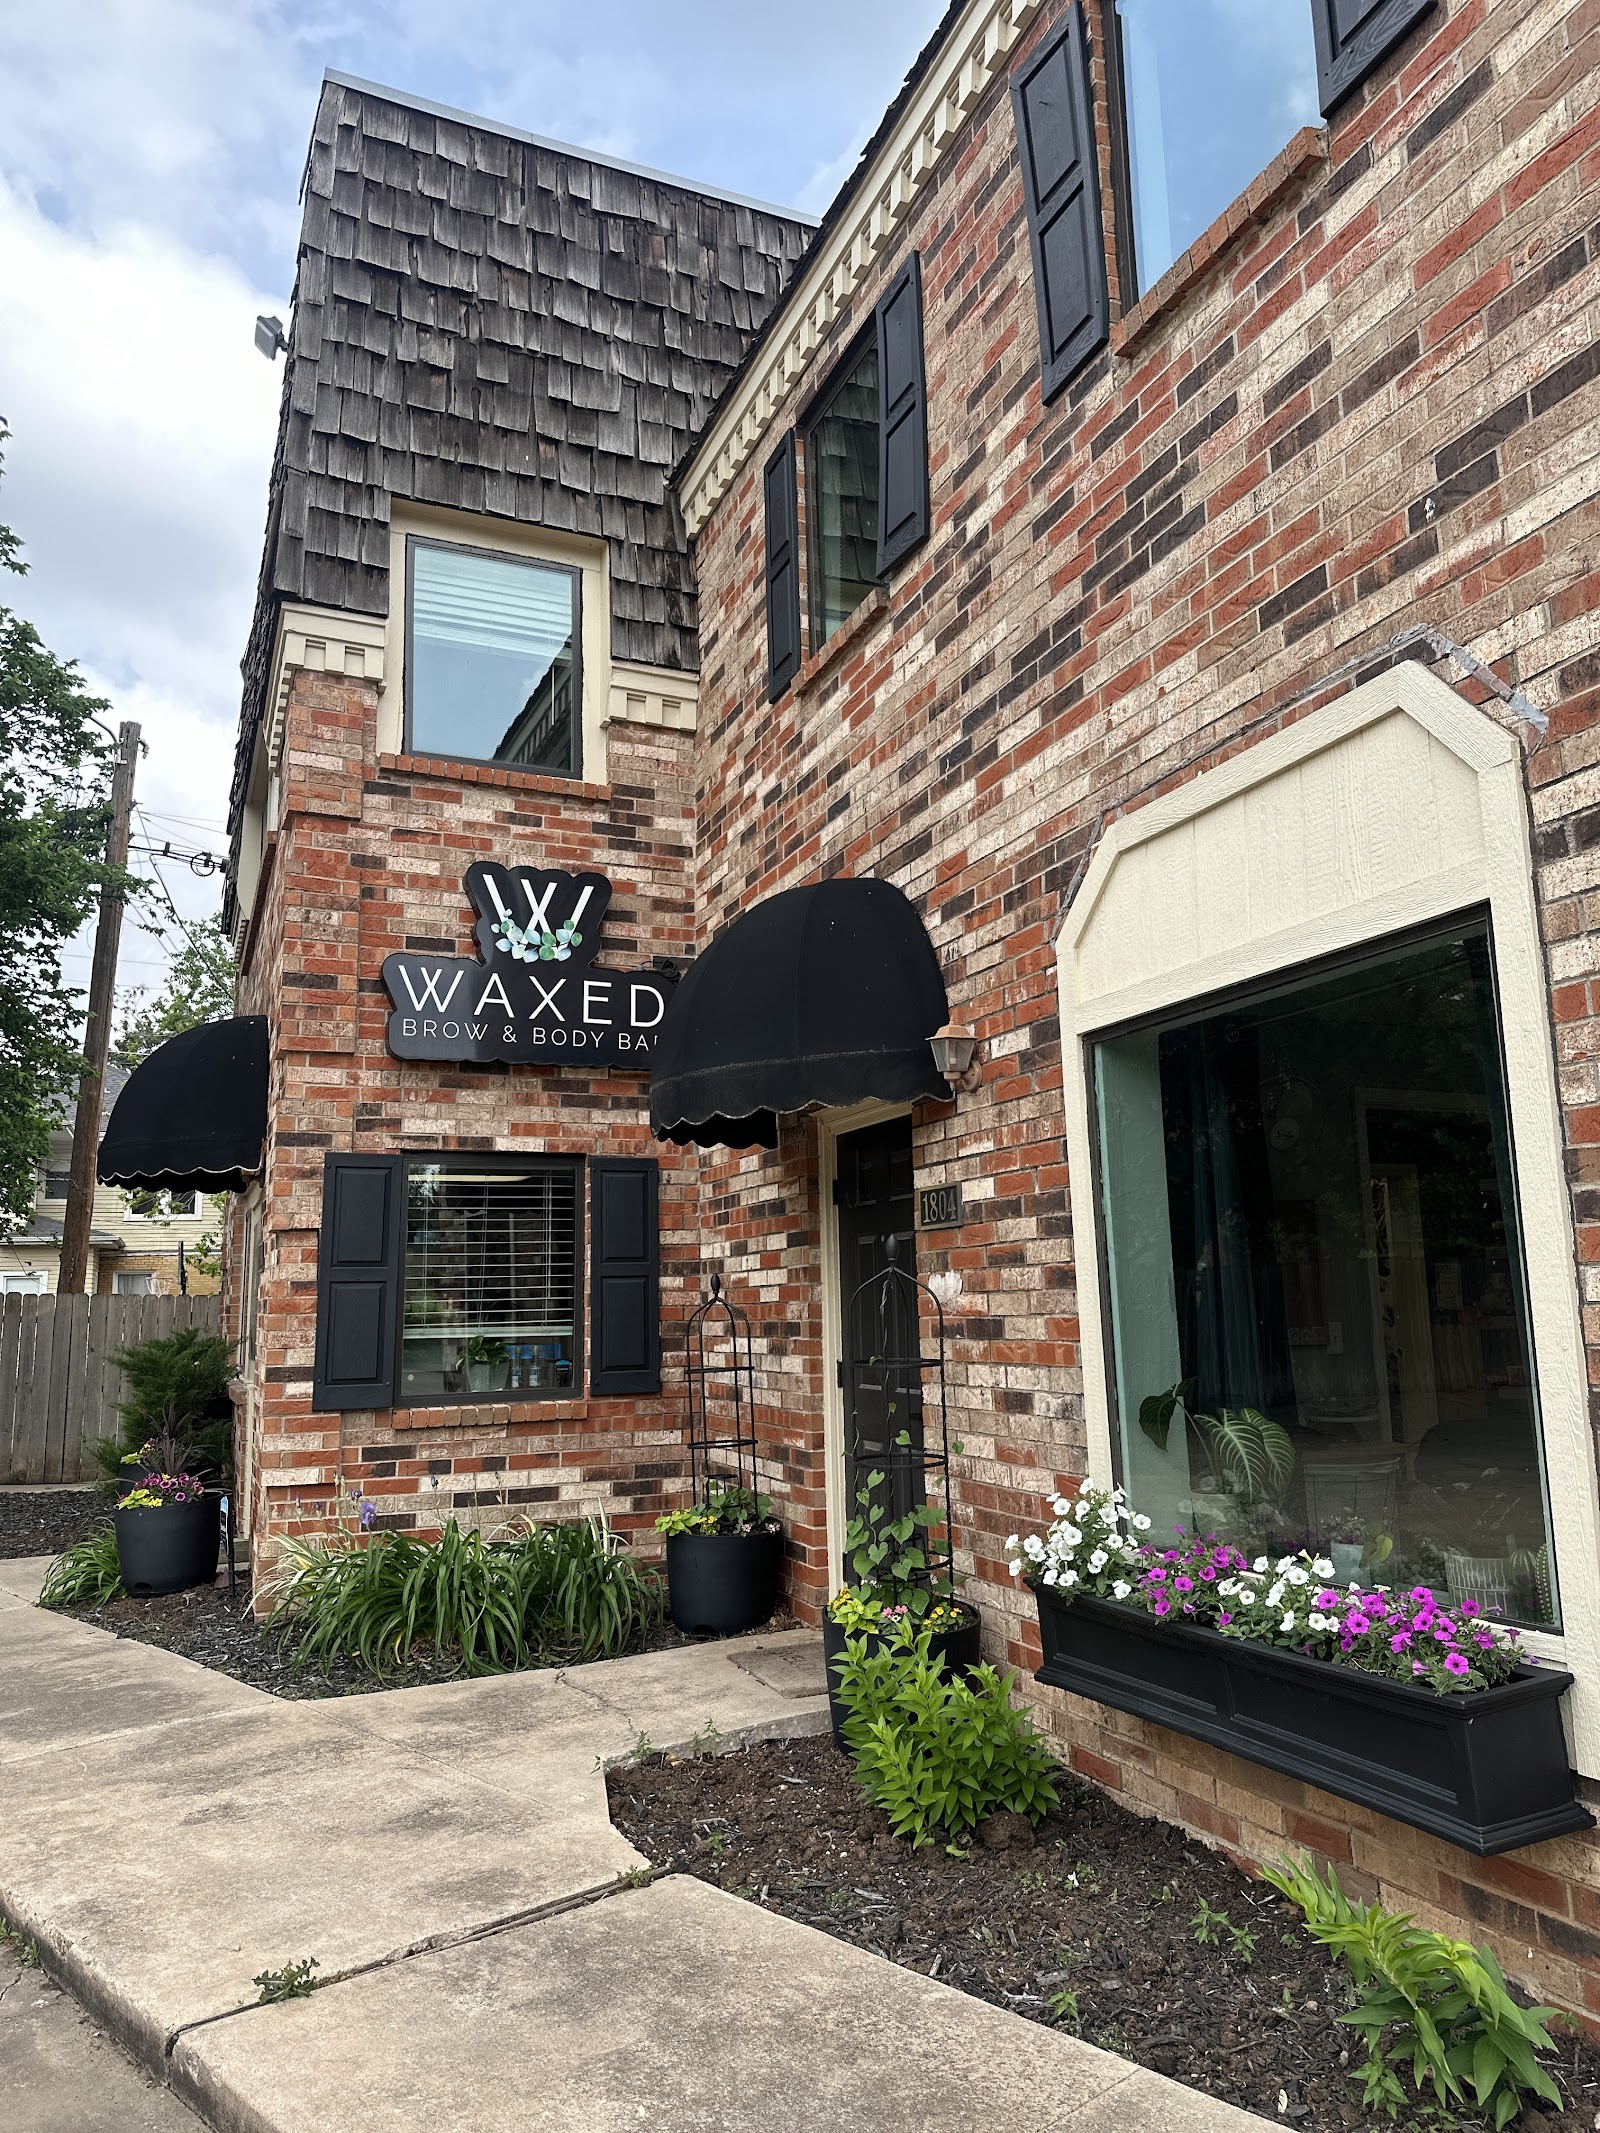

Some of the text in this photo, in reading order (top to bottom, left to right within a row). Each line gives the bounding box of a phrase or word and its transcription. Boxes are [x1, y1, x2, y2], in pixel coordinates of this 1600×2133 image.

[398, 964, 666, 1028] WAXED
[402, 1018, 489, 1041] BROW
[502, 1025, 518, 1043] &
[532, 1027, 605, 1050] BODY
[922, 1189, 957, 1223] 1804
